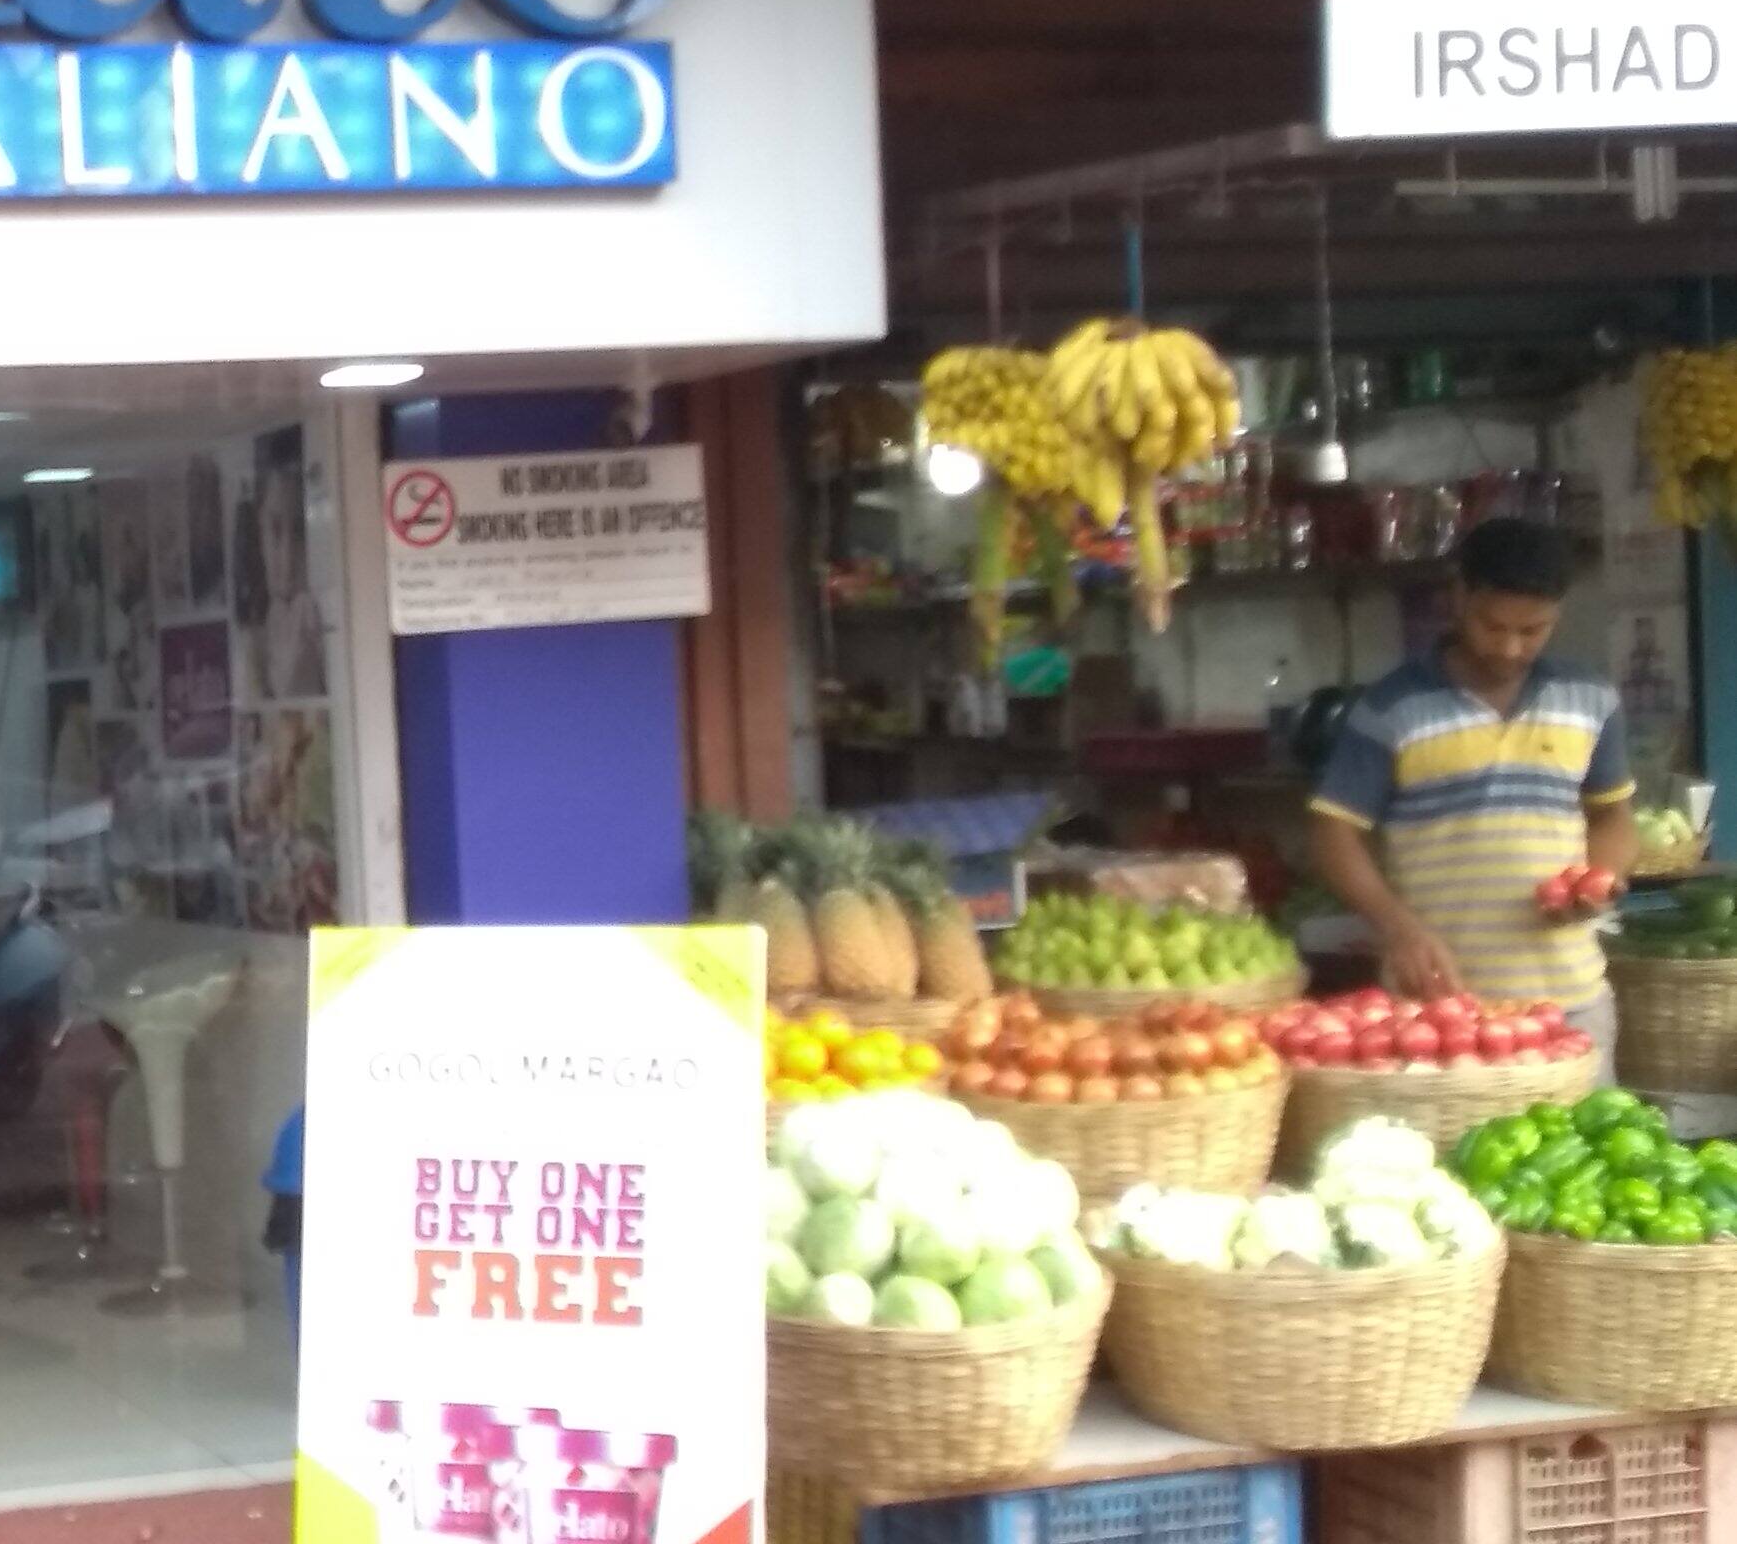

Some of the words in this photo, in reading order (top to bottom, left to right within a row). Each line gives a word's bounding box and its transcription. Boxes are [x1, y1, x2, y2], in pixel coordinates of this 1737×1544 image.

[1414, 24, 1720, 97] IRSHAD
[415, 1158, 518, 1203] BUY
[540, 1161, 646, 1207] ONE
[415, 1202, 514, 1244] GET
[536, 1206, 645, 1251] ONE
[412, 1249, 645, 1327] FREE
